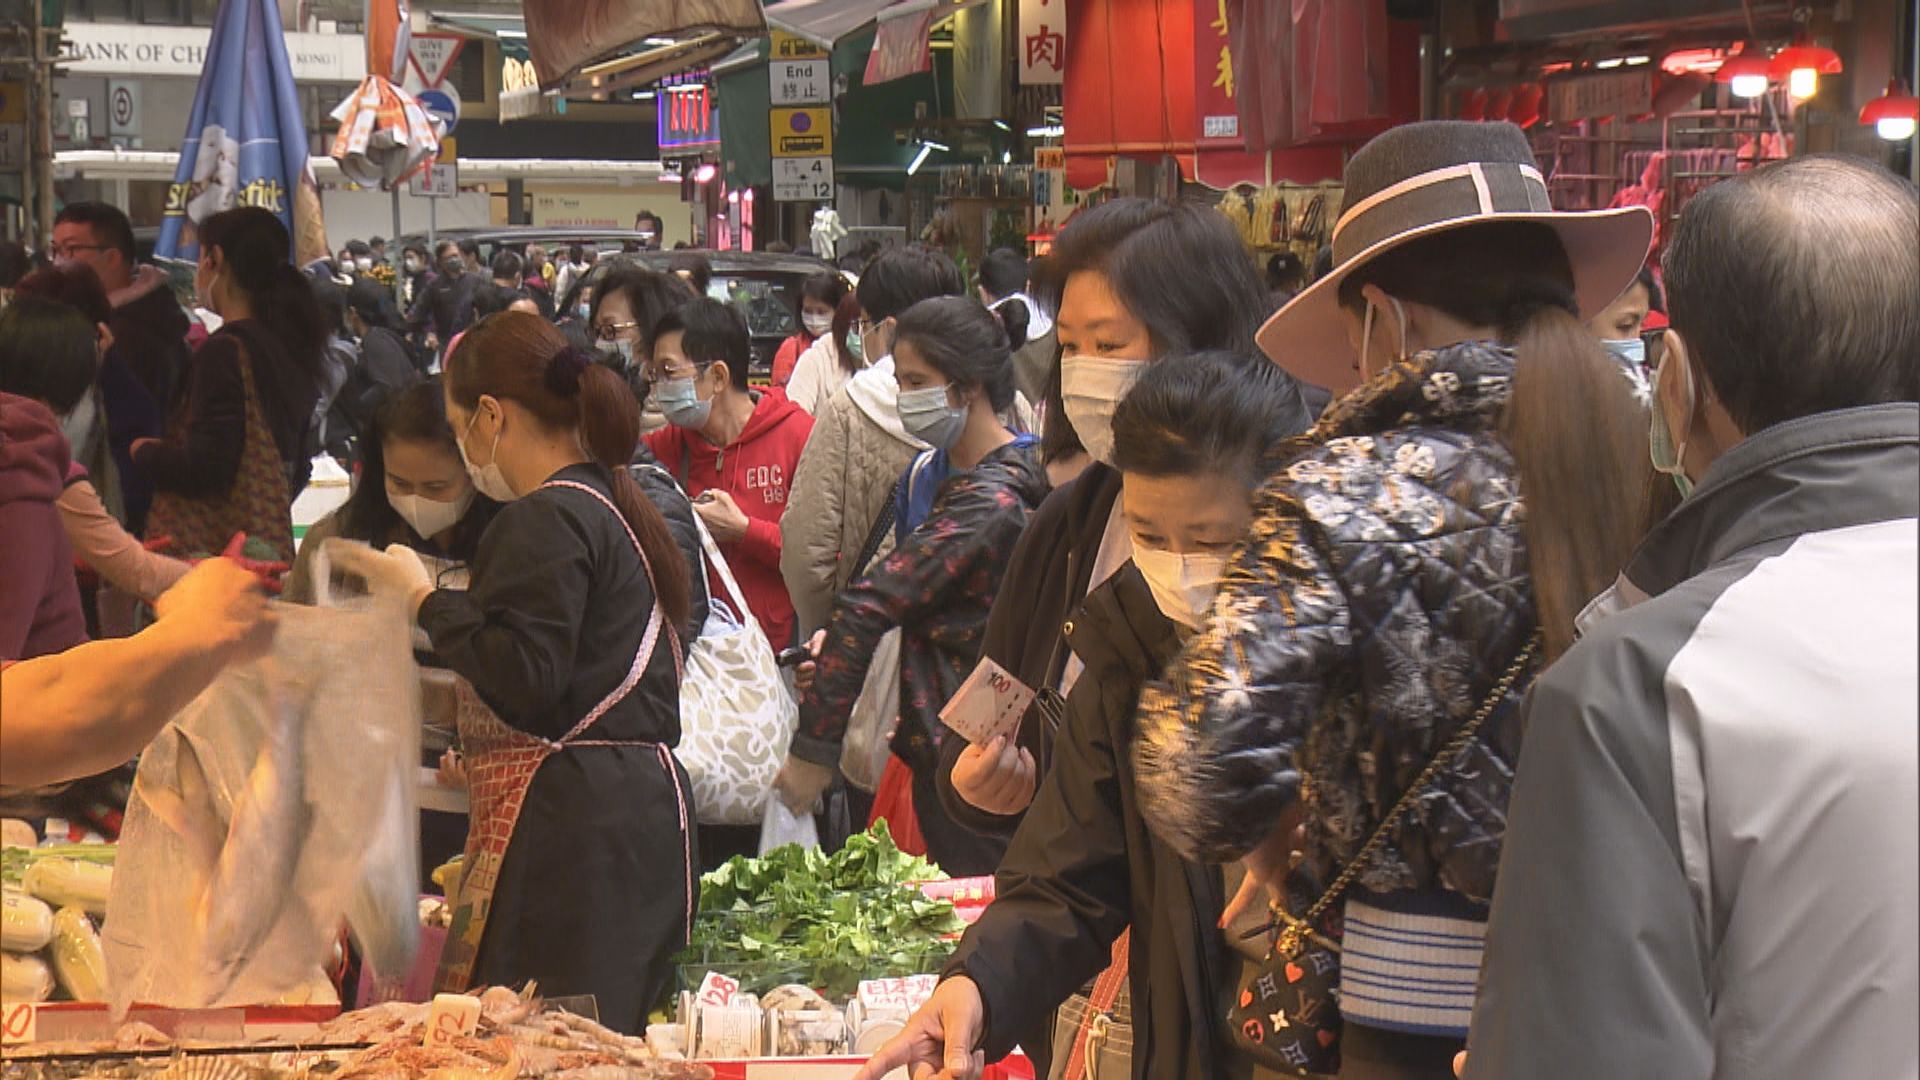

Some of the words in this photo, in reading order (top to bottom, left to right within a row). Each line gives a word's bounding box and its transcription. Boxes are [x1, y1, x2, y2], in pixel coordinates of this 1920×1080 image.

[67, 42, 128, 60] BANK
[136, 44, 164, 62] OF
[171, 45, 207, 63] CH
[786, 64, 813, 78] End
[811, 159, 823, 174] 4
[813, 182, 831, 198] 12
[987, 671, 1011, 693] 100
